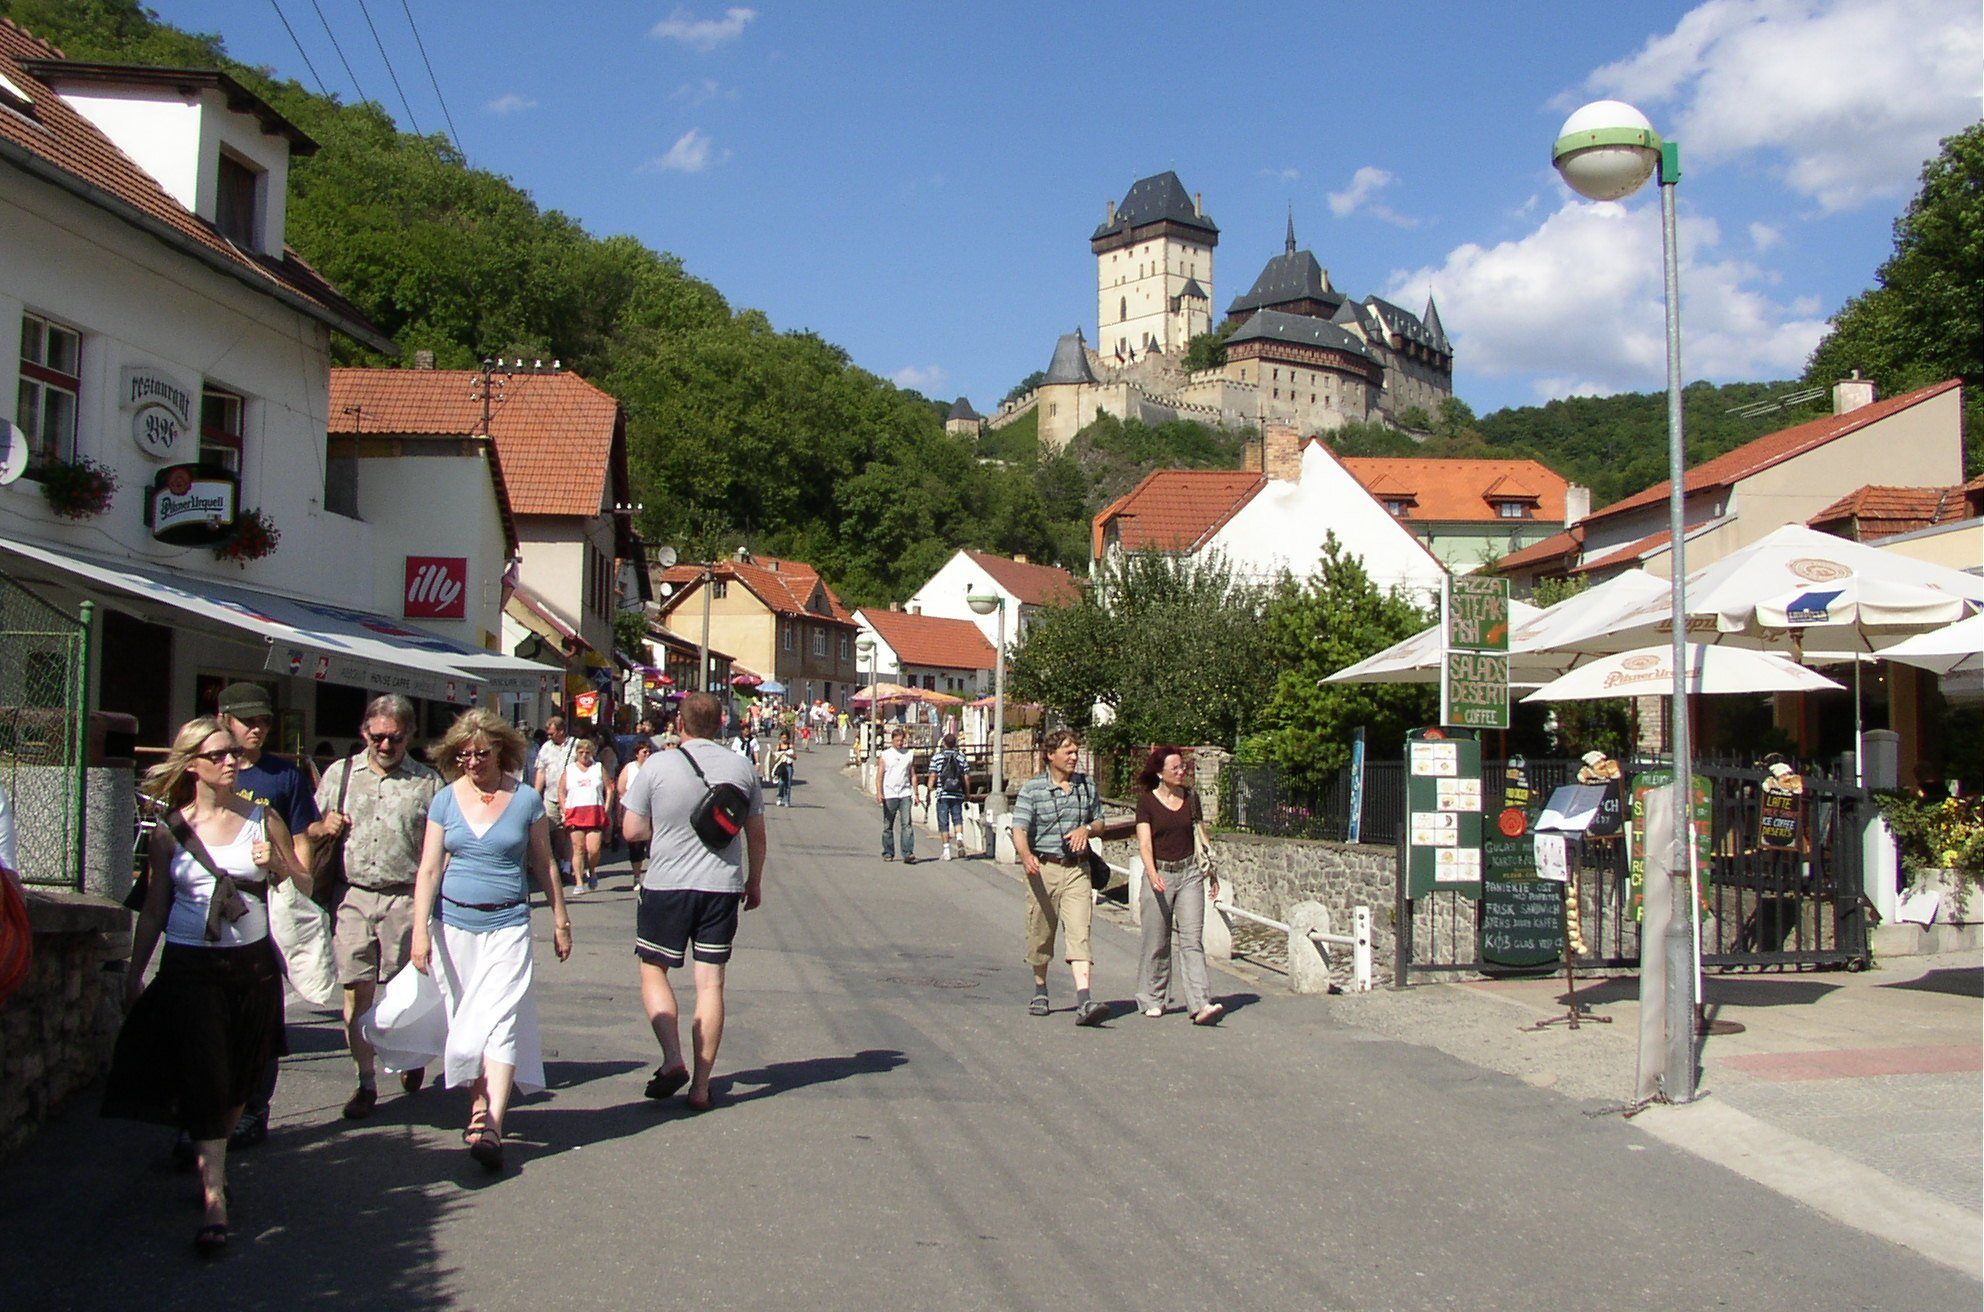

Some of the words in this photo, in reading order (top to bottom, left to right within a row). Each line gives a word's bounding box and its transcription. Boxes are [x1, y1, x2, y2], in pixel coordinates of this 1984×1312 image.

[131, 376, 190, 422] restaurant
[160, 496, 191, 520] Pilsner
[191, 495, 223, 511] Urquell
[408, 564, 462, 612] illy
[1451, 594, 1507, 620] STEAKS
[1451, 618, 1480, 643] FISH
[1450, 655, 1507, 682] SALADS
[1604, 671, 1652, 689] Pilsner
[1451, 681, 1506, 705] DESERT
[1464, 709, 1498, 725] COFFEE
[1766, 795, 1792, 810] LATTE
